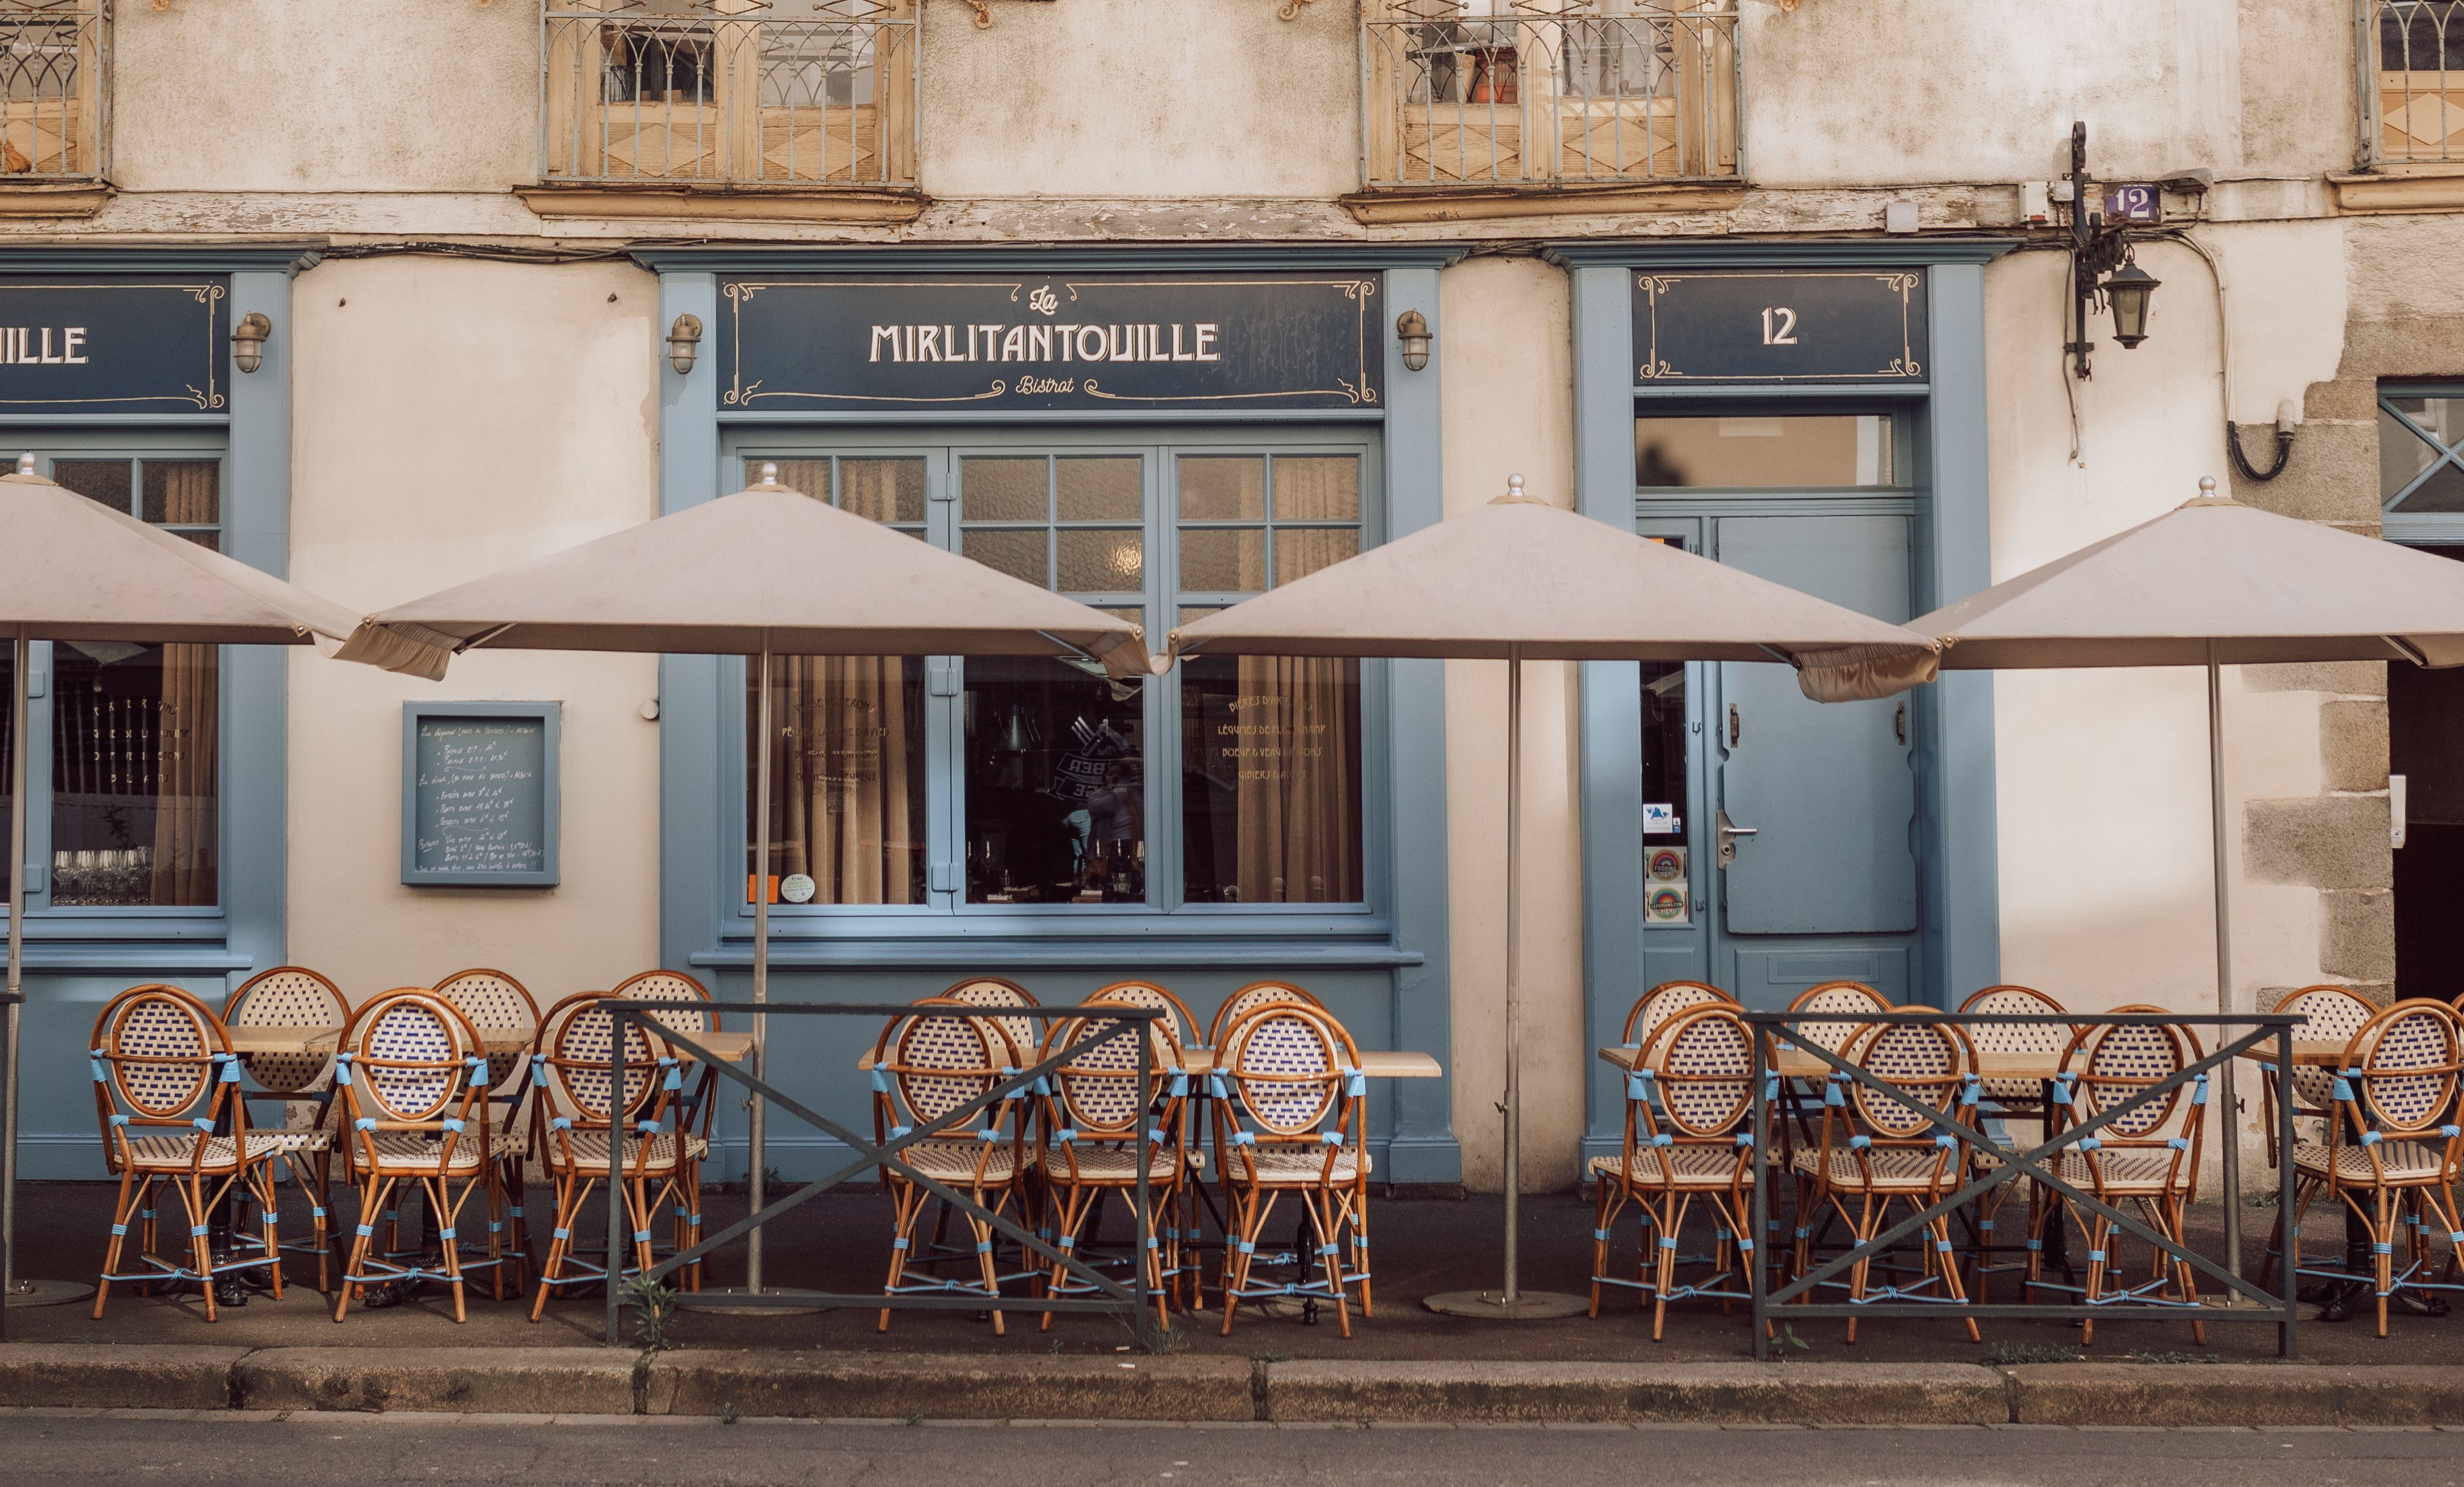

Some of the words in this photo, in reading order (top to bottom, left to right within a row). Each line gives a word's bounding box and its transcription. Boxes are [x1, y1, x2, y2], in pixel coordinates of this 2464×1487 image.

[2116, 189, 2150, 218] 12
[1029, 284, 1059, 315] La
[1761, 307, 1798, 345] 12
[0, 326, 89, 364] ILLE
[869, 323, 1221, 363] MIRLITANTOUILLE
[1016, 375, 1075, 395] Bistrot
[1218, 724, 1257, 735] LÉGUMES
[1259, 725, 1270, 735] DE
[1298, 725, 1326, 735] HAMP
[1222, 747, 1250, 757] BOEUF
[1252, 747, 1258, 757] &
[1259, 747, 1281, 757] VEAU
[1238, 770, 1270, 780] GIBIERS
[1273, 771, 1279, 780] &
